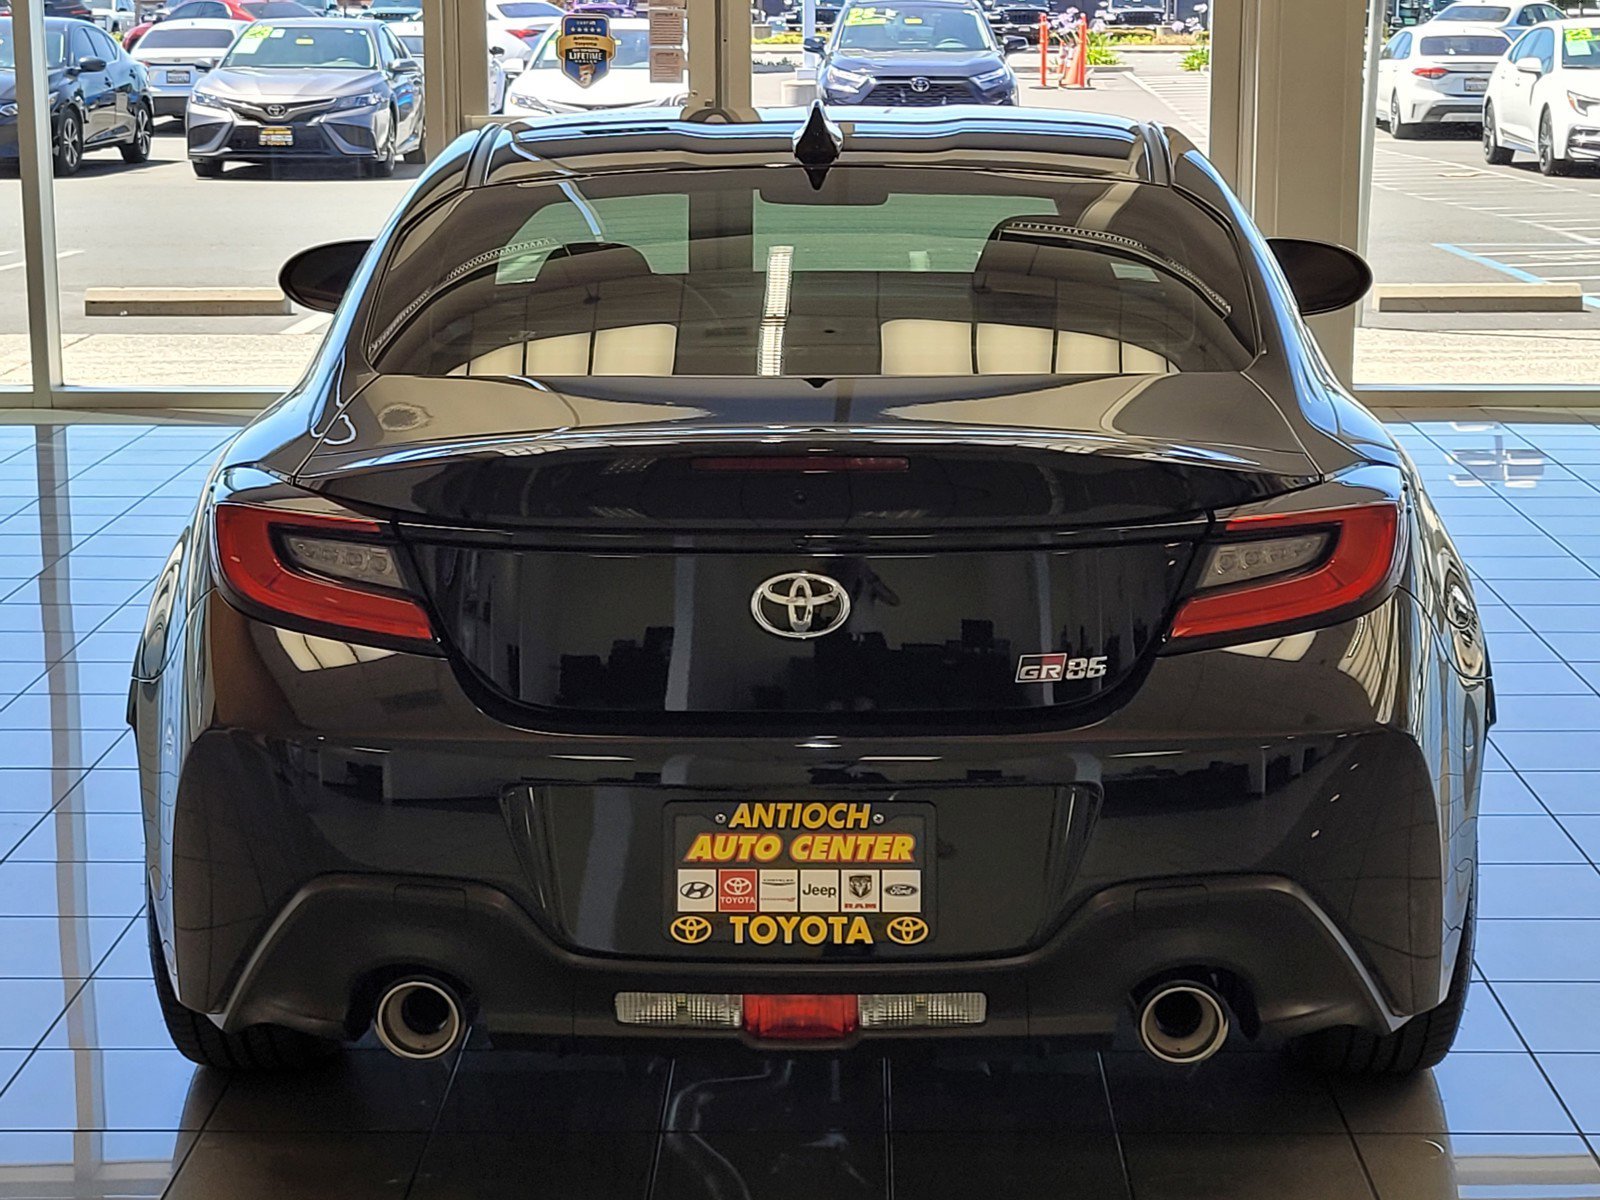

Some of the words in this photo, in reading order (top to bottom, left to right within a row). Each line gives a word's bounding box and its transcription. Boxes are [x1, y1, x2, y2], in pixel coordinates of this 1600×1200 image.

[569, 52, 602, 60] LIFETIME
[728, 802, 871, 829] ANTIOCH
[684, 833, 784, 862] AUTO
[789, 833, 916, 862] CENTER
[720, 896, 756, 905] TOYOTA
[802, 883, 837, 898] Jeep
[729, 915, 873, 945] TOYOTA
